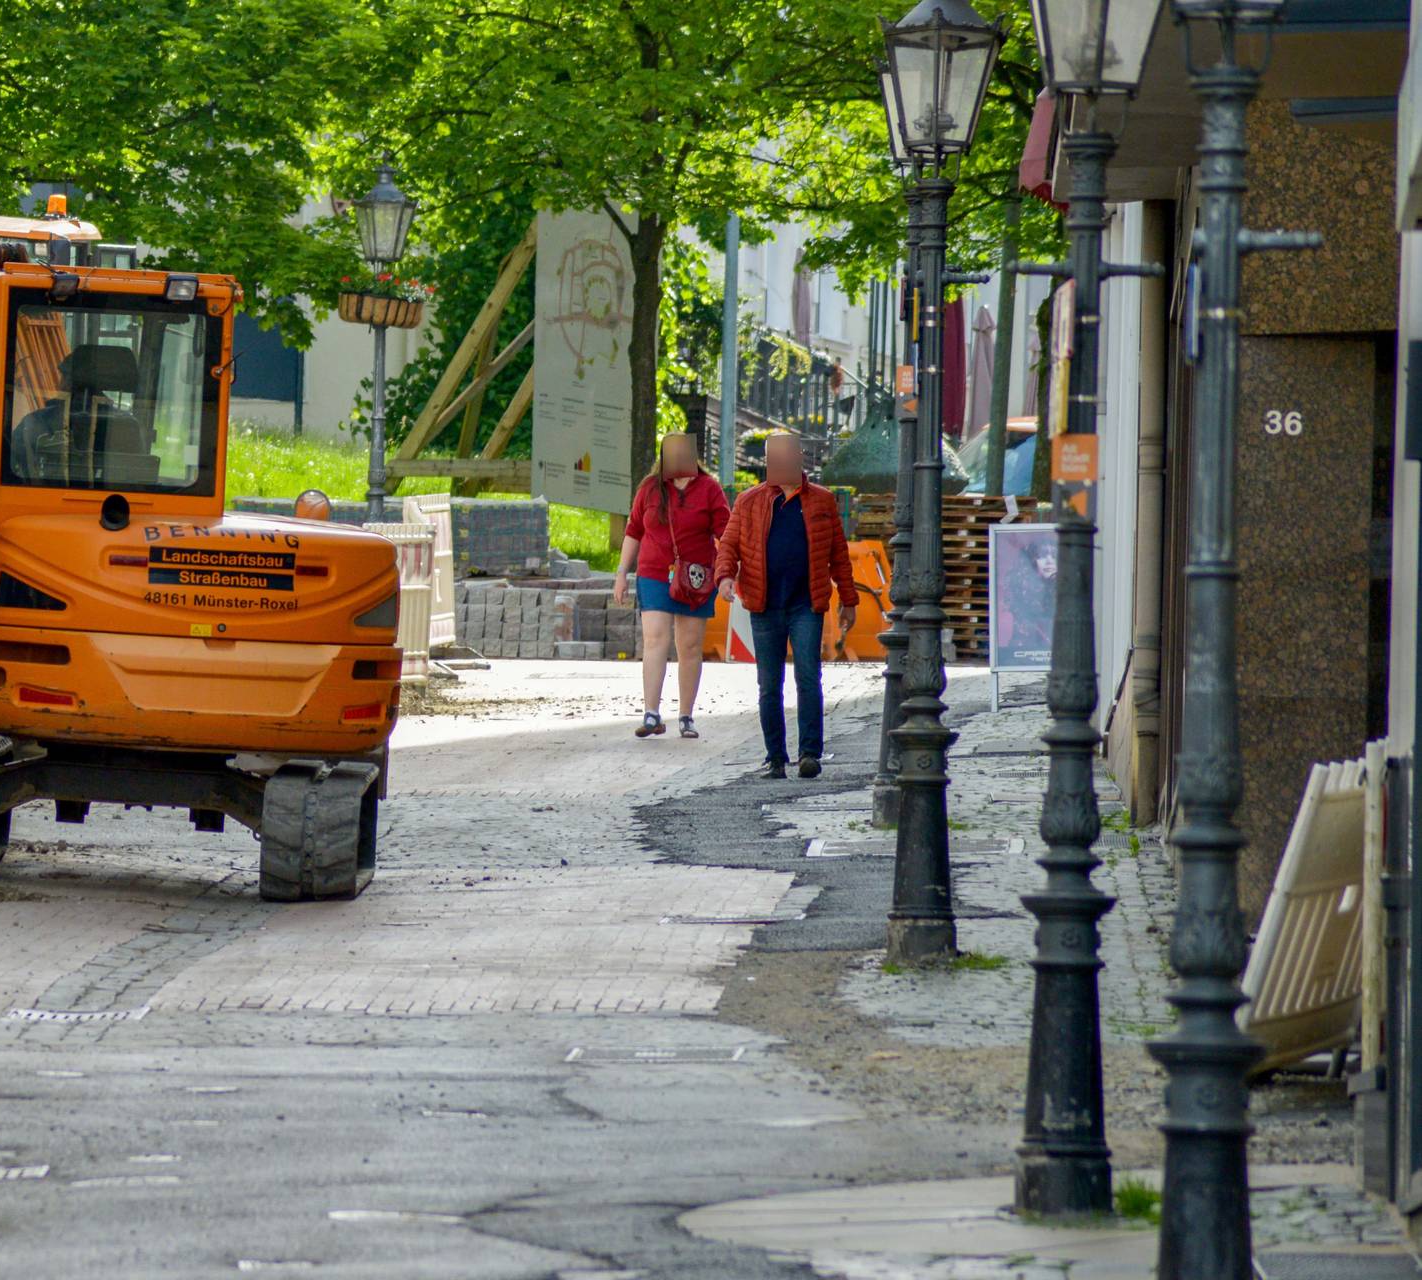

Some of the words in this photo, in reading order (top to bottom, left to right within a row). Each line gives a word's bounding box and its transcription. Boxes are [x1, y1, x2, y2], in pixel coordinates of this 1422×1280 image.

[1265, 410, 1303, 436] 36
[144, 525, 300, 549] BENNING
[162, 549, 284, 568] Landschaftsbau
[179, 571, 268, 588] Straßenbau
[144, 592, 187, 606] 48161
[193, 594, 299, 611] Münster-Roxel
